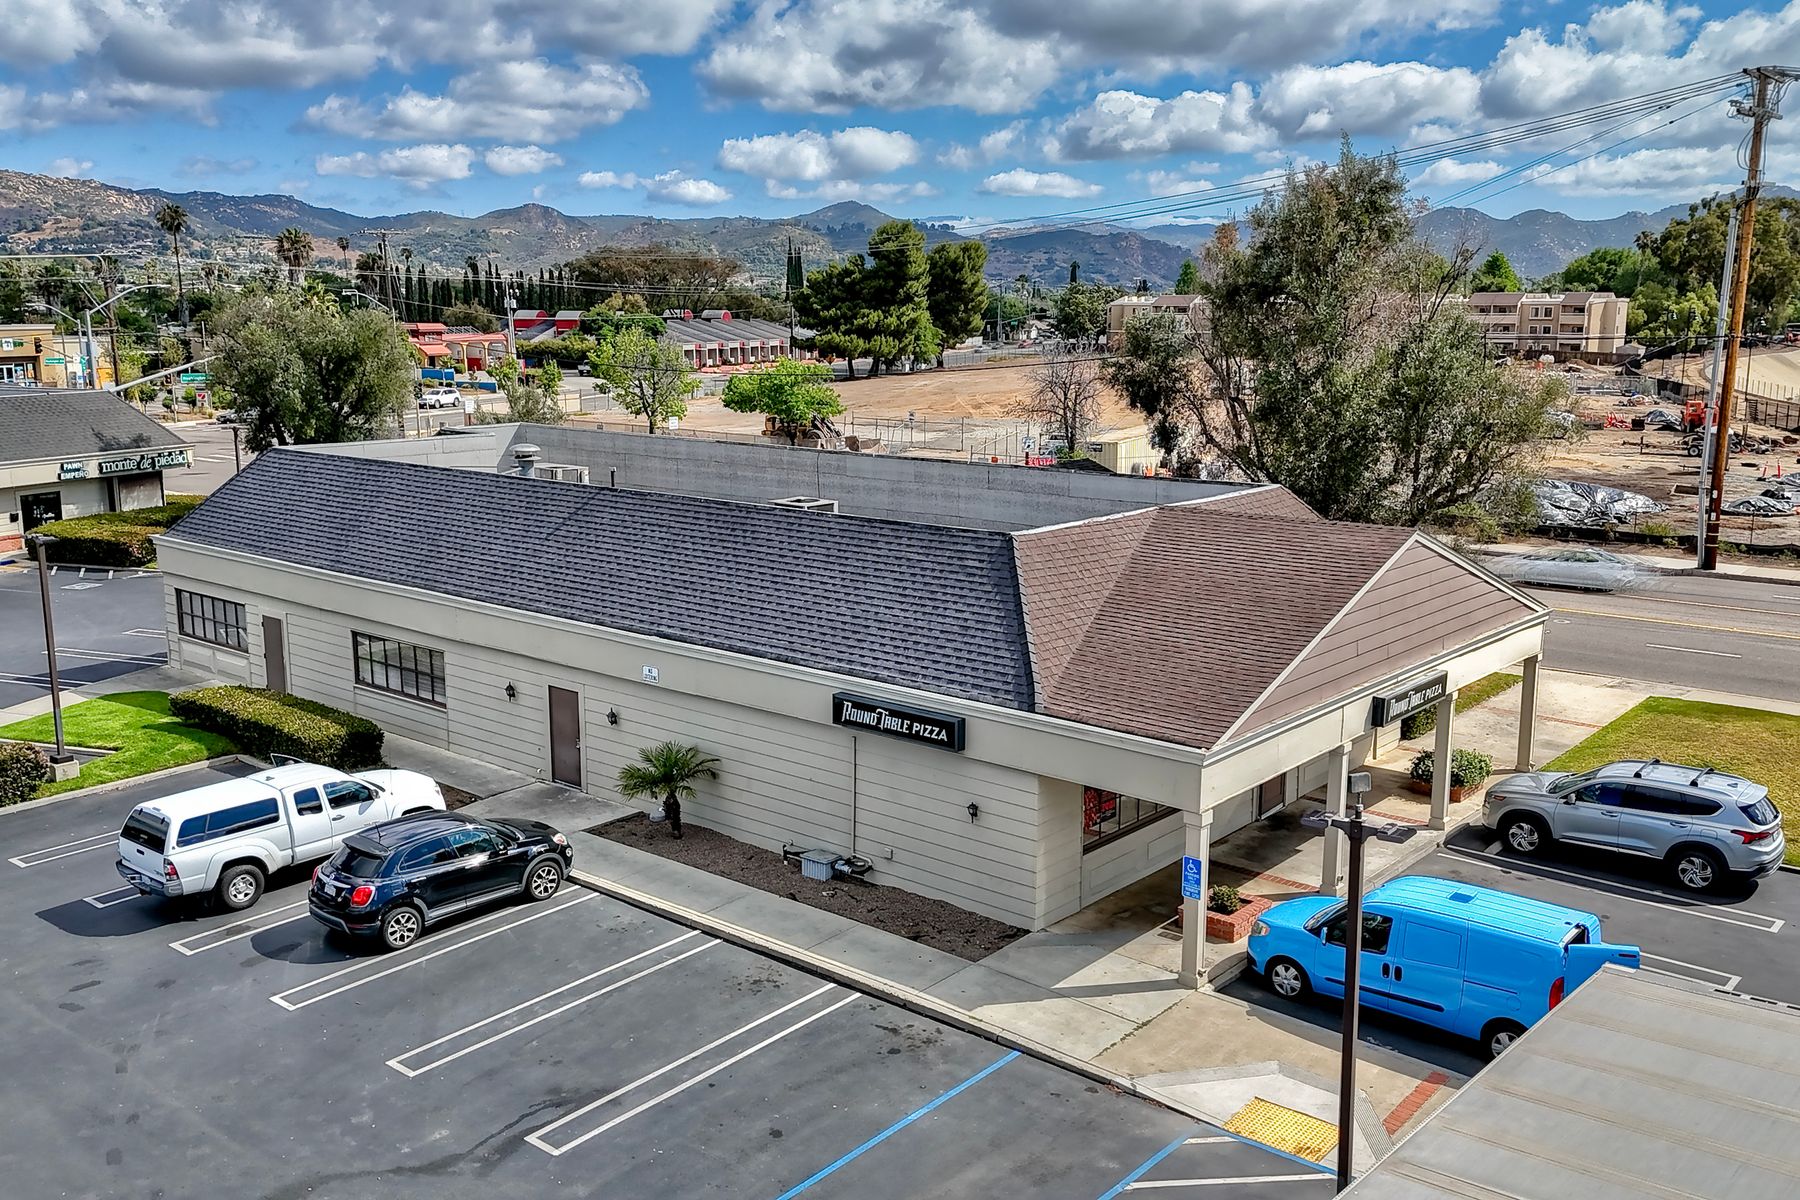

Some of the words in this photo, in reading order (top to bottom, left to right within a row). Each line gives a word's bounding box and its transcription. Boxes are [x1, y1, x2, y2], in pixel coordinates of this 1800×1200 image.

[63, 462, 83, 471] PAWN
[102, 459, 137, 473] monte
[140, 454, 152, 469] de
[154, 450, 187, 470] piedad
[1388, 699, 1408, 721] ROUND
[1408, 691, 1425, 709] TABLE
[1425, 684, 1442, 700] PIZZA
[841, 701, 878, 725] ROUND
[876, 708, 910, 732] TABLE
[912, 722, 947, 742] PIZZA
